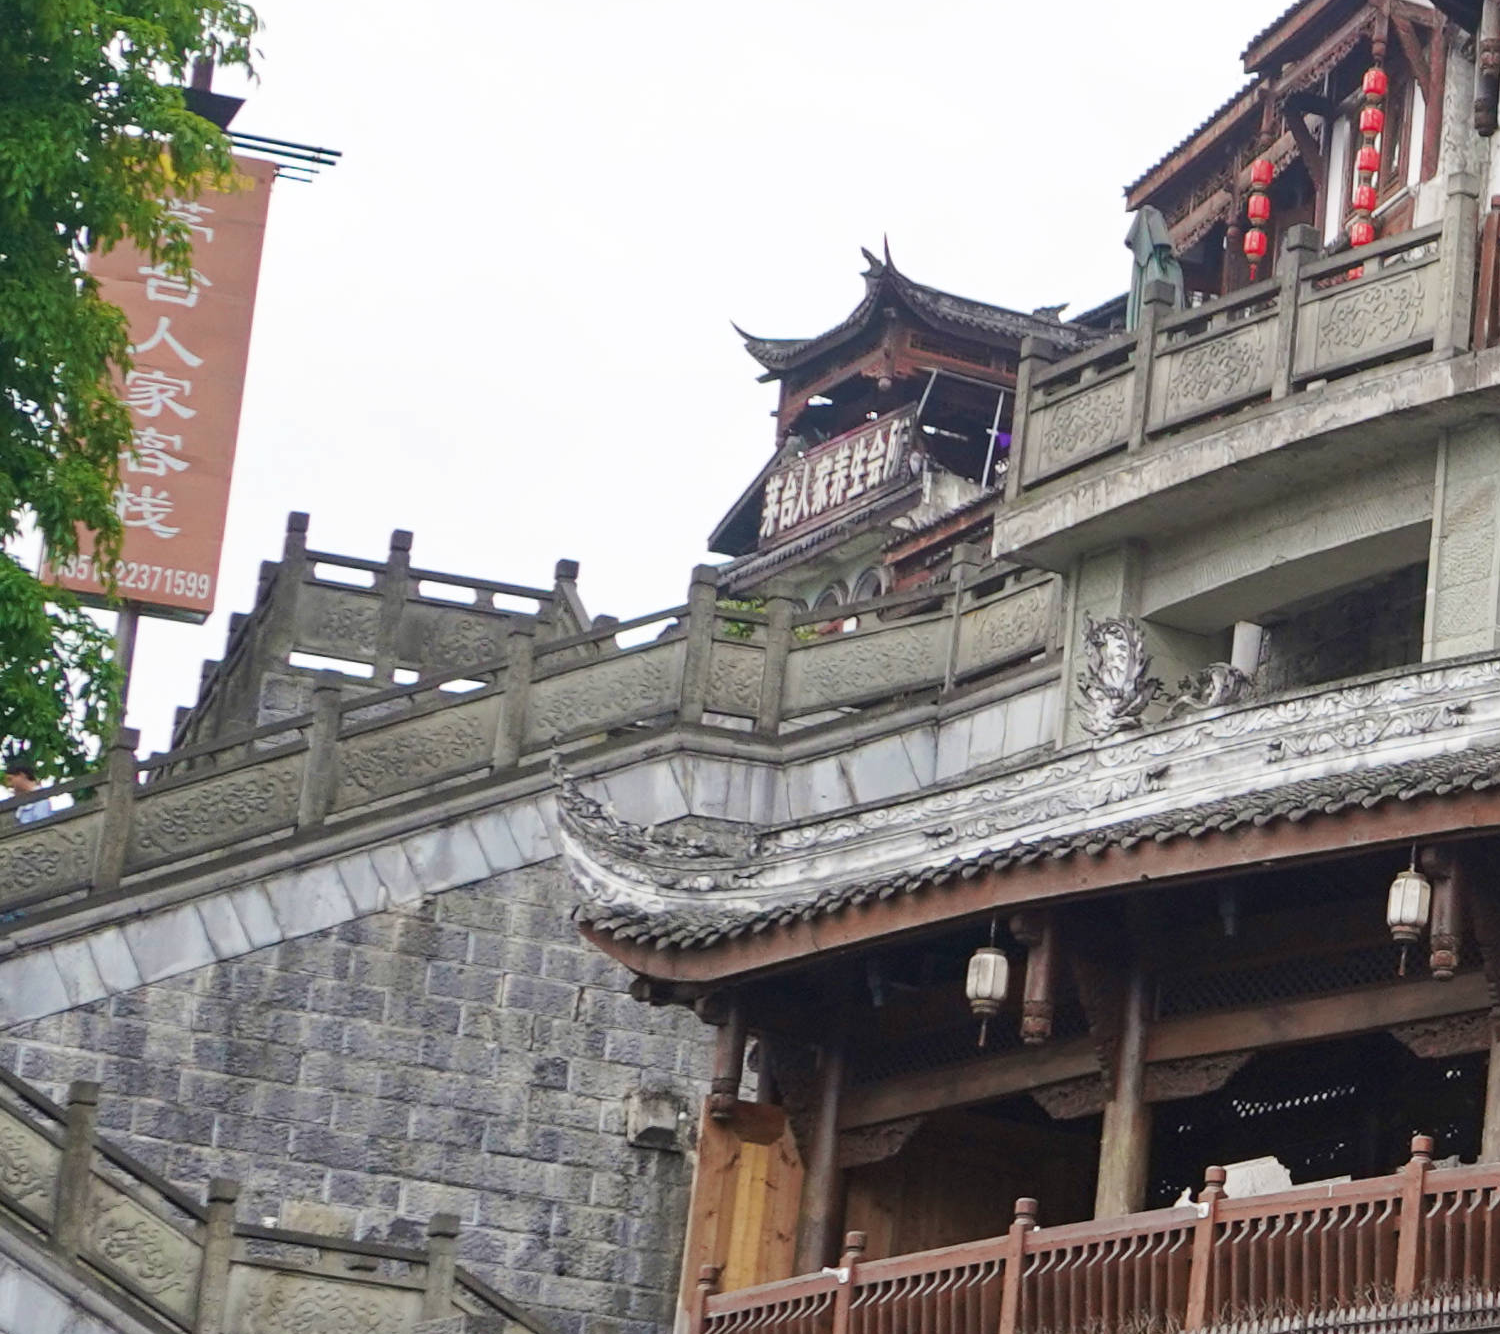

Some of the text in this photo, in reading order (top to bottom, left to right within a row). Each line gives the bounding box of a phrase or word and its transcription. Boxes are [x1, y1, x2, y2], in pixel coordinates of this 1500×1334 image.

[760, 418, 911, 538] 茅台人家养生会所
